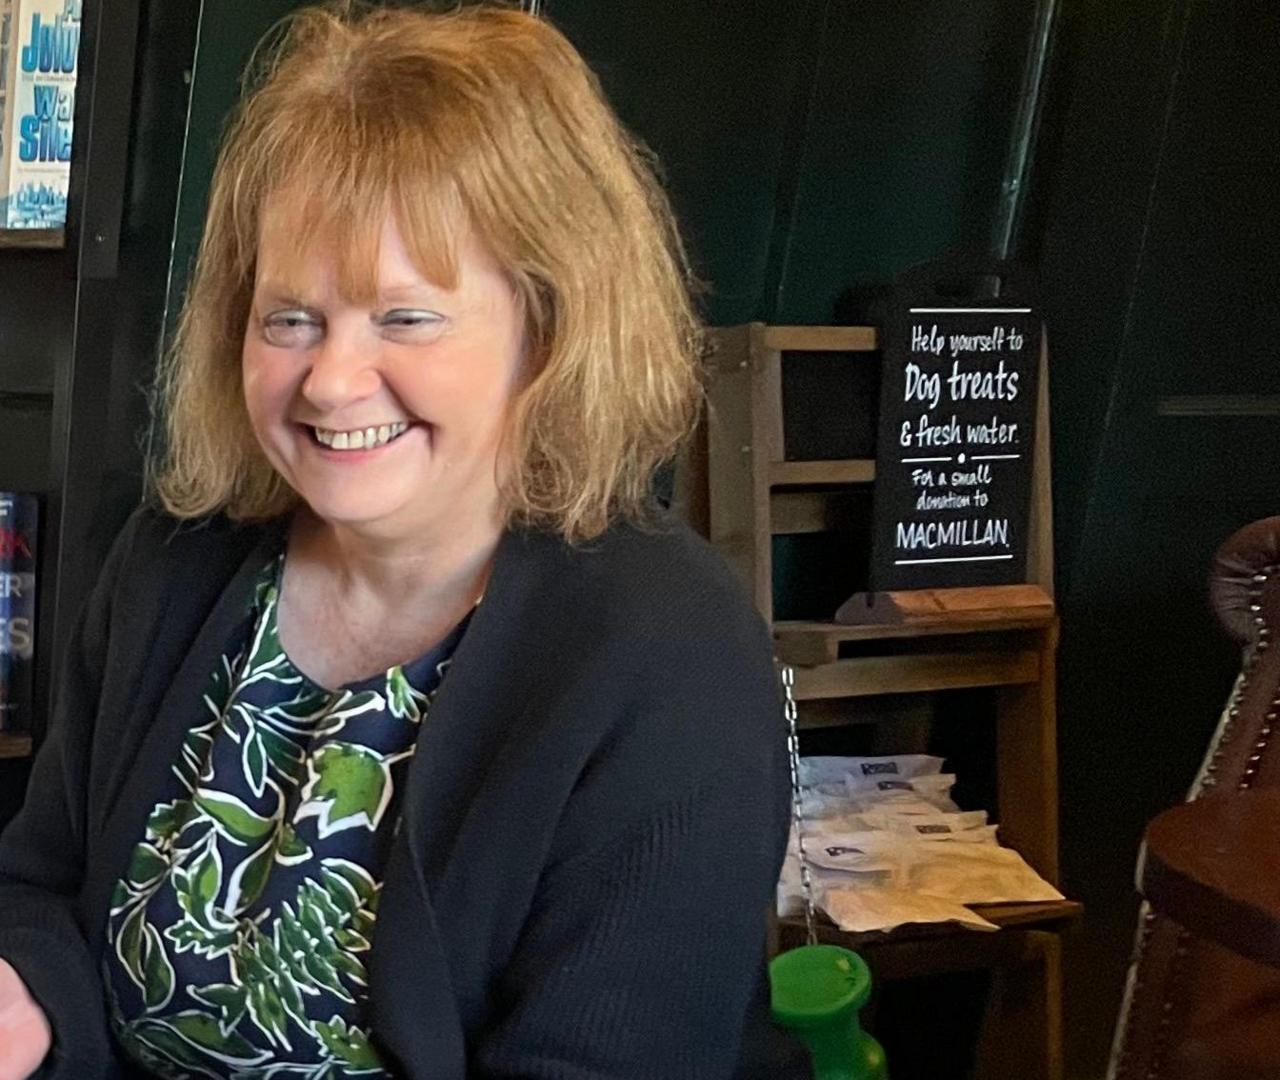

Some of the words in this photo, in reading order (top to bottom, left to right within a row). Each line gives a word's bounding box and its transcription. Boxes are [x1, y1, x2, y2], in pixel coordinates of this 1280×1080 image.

[911, 325, 944, 356] Help
[950, 326, 1004, 357] yourself
[1006, 327, 1023, 350] to
[905, 362, 940, 409] Dog
[947, 360, 1019, 401] treats
[900, 421, 912, 447] &
[915, 415, 961, 447] fresh
[938, 474, 947, 486] a
[951, 465, 992, 486] small
[916, 491, 970, 511] donation
[973, 489, 988, 508] to
